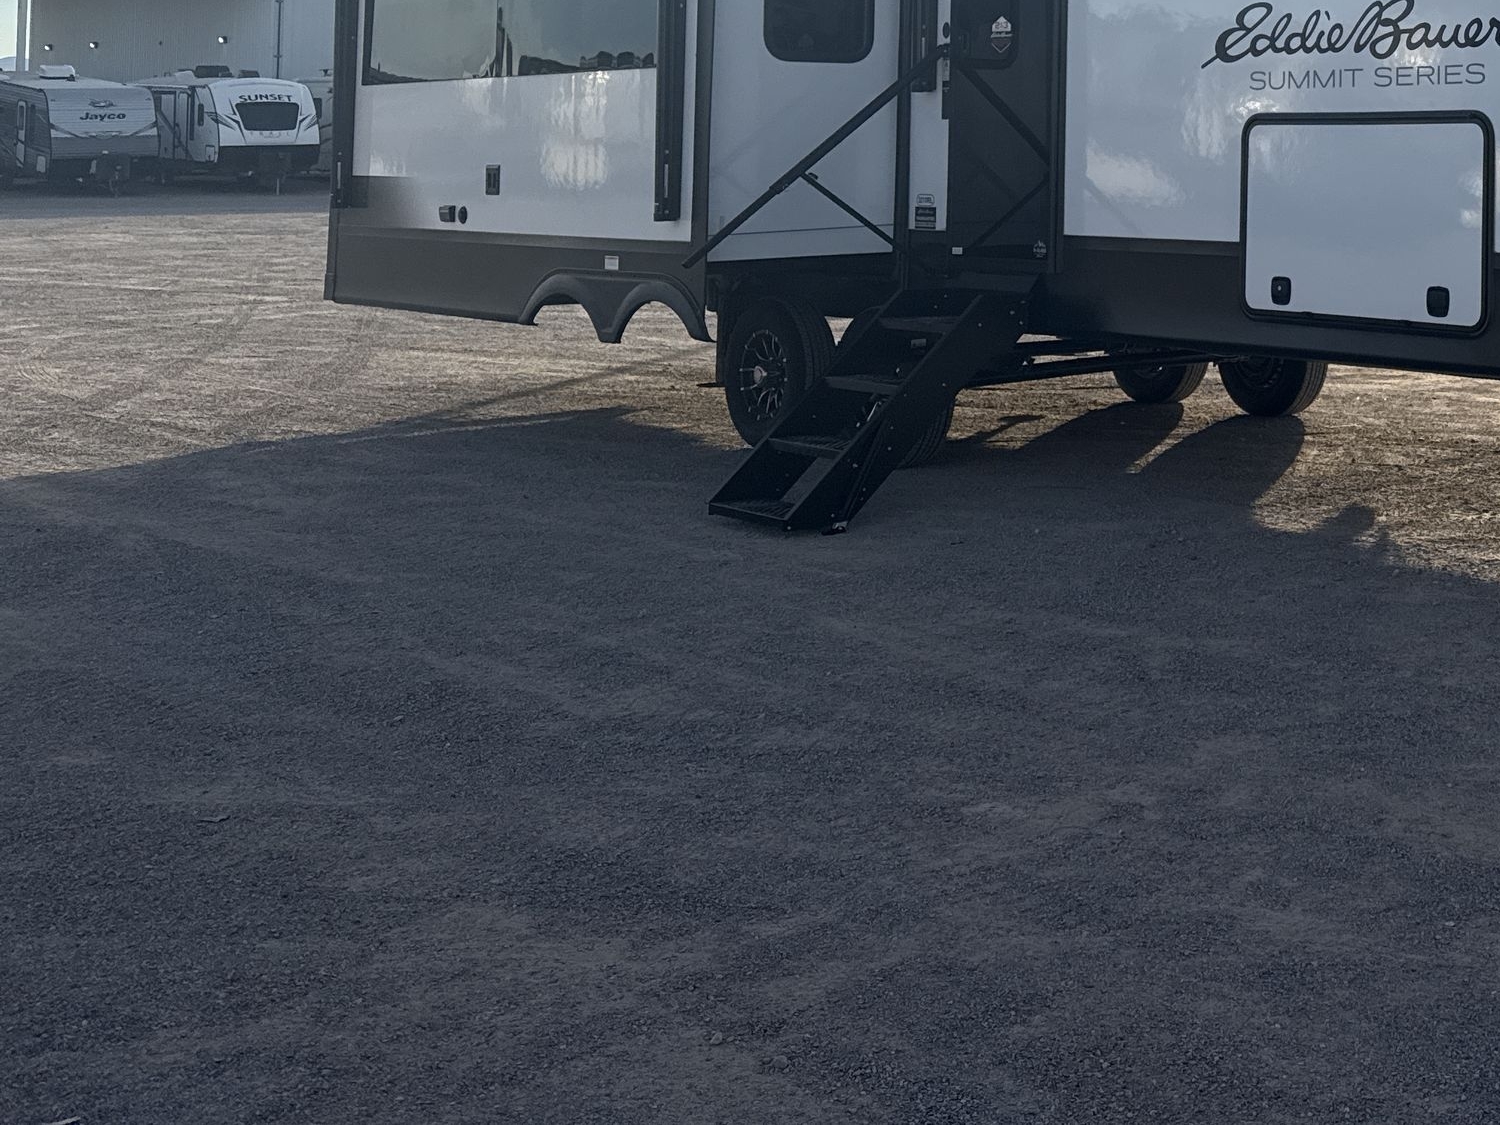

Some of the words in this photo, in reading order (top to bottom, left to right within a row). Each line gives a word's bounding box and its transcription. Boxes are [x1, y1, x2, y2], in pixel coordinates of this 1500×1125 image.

[1200, 2, 1353, 68] Eddie
[1249, 69, 1363, 91] SUMMIT
[1373, 63, 1486, 87] SERIES
[239, 93, 293, 102] SUNSET
[80, 112, 126, 121] Jayco
